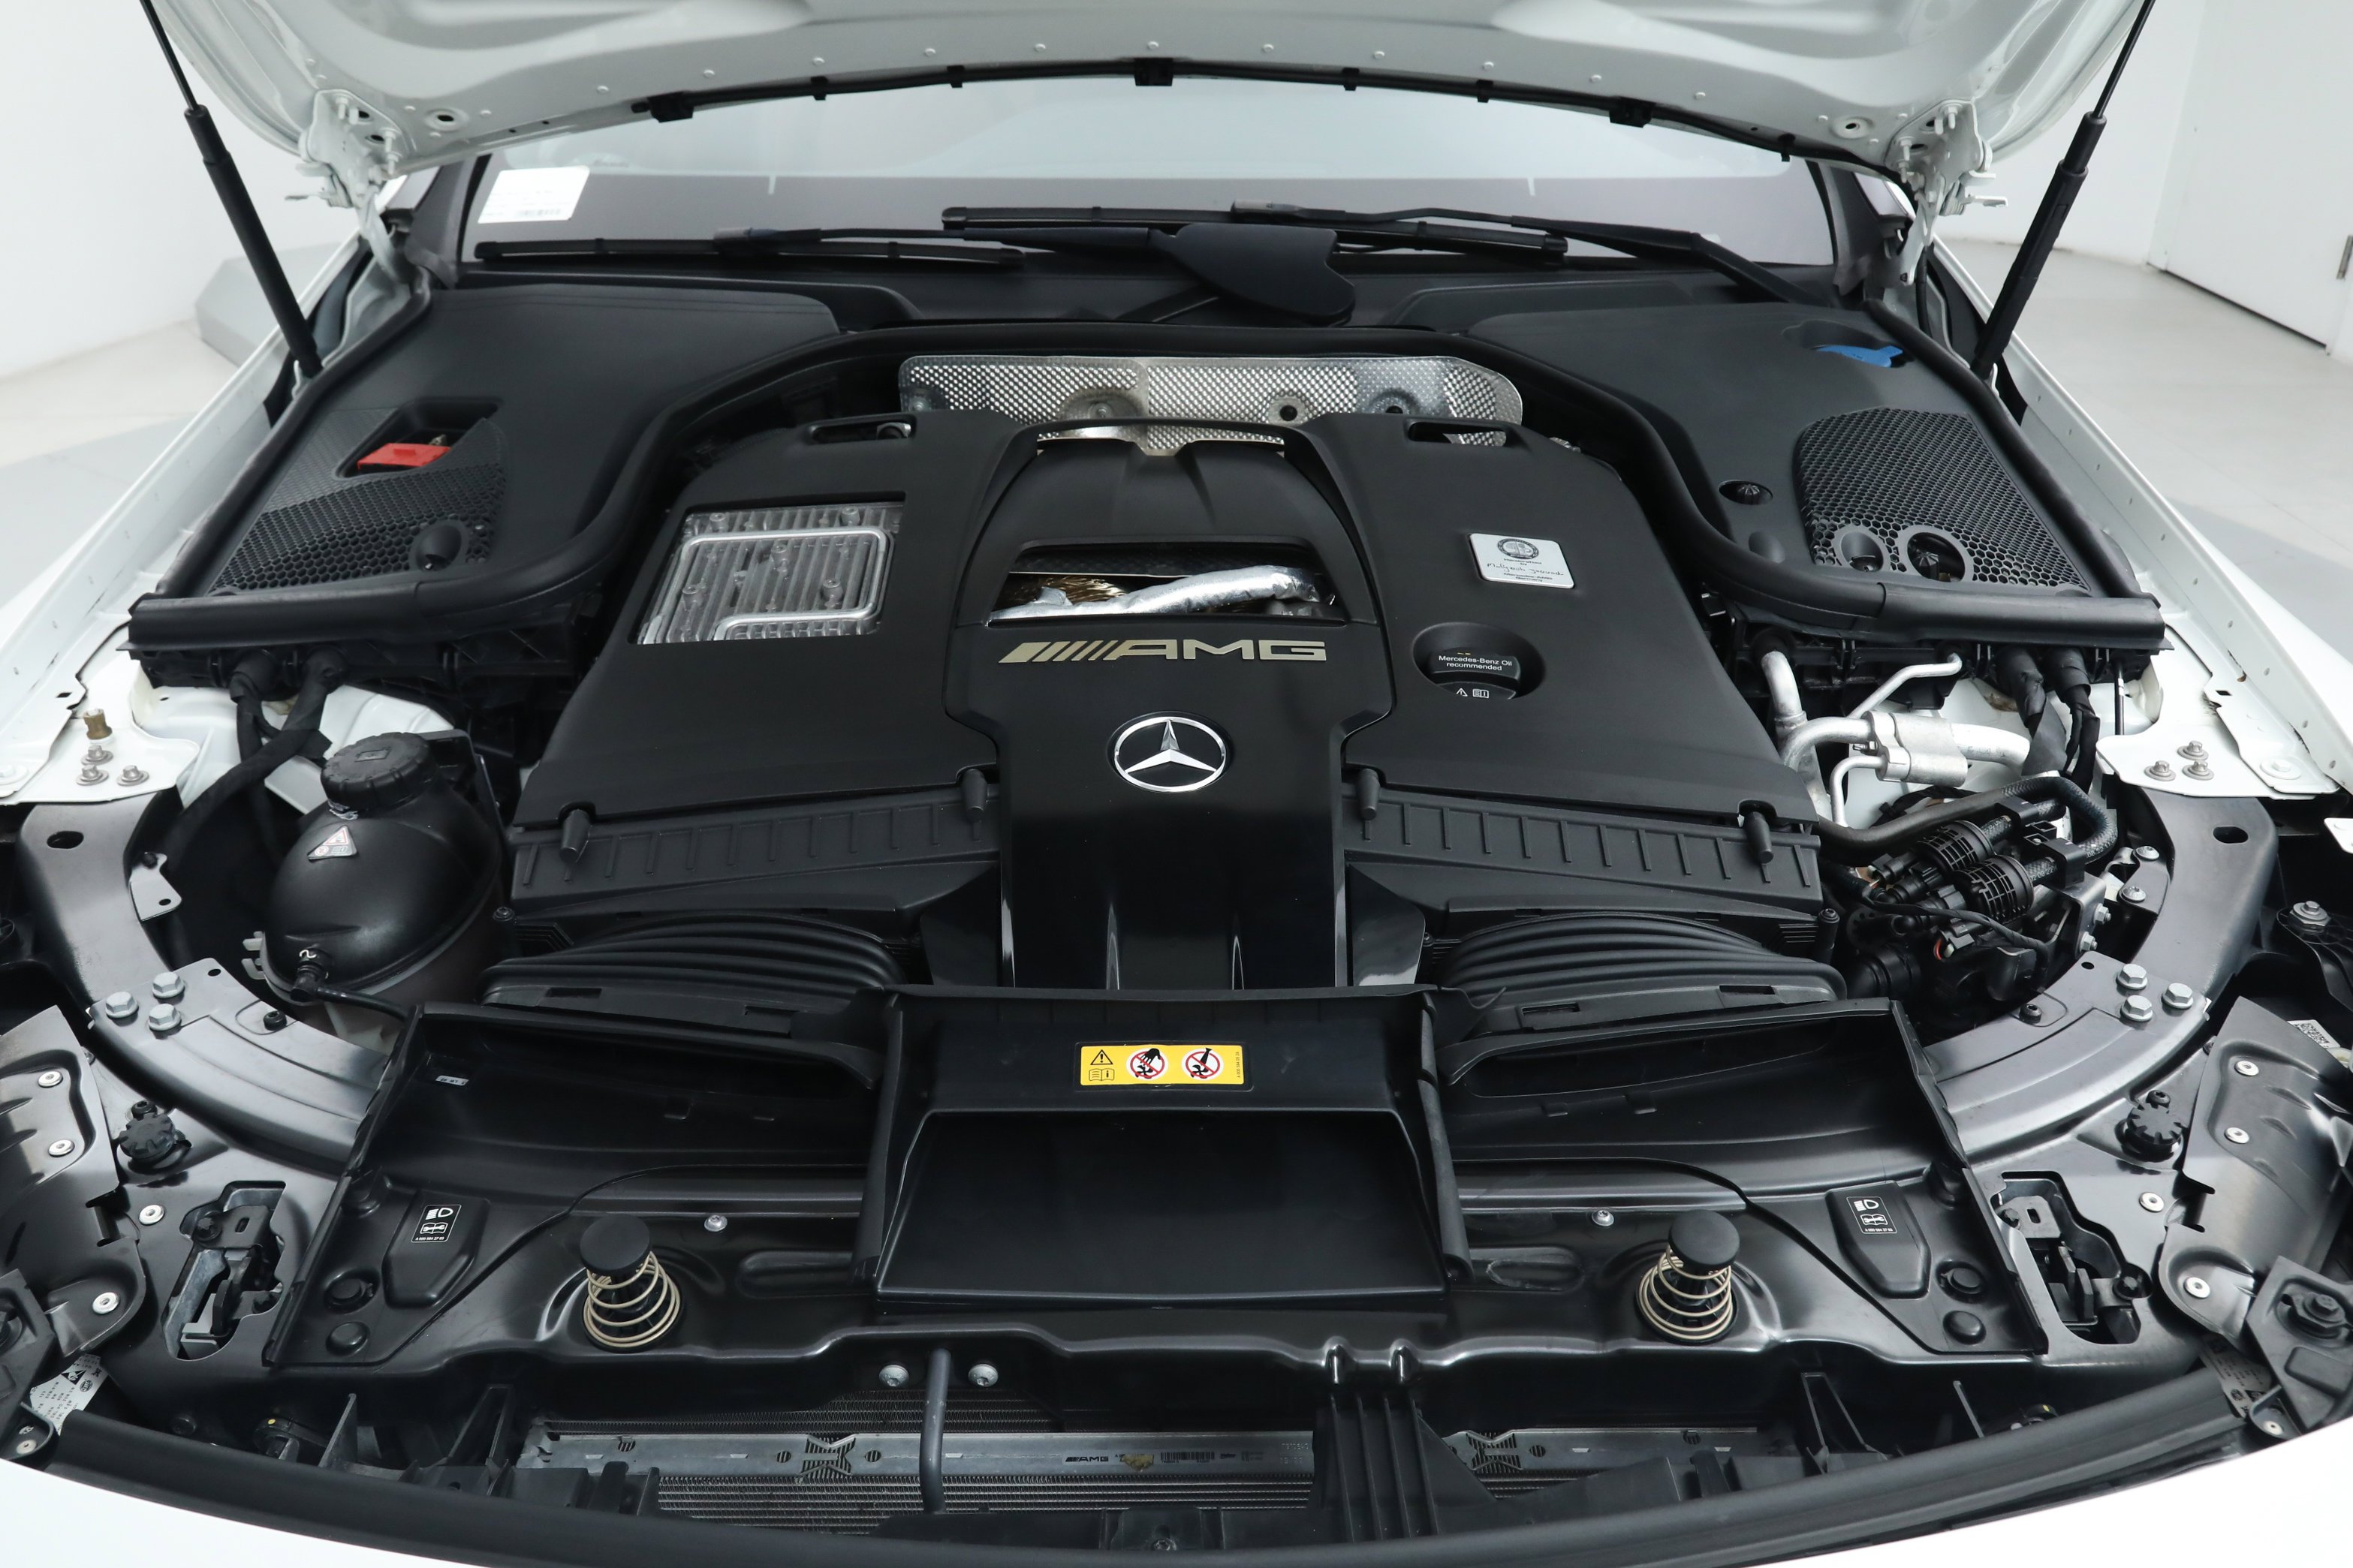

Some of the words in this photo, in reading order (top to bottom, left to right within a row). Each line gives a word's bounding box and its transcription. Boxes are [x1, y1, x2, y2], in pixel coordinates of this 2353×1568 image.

[1102, 639, 1327, 661] AMG
[1439, 655, 1500, 666] Mercedes-Benz
[1446, 662, 1502, 671] recommended
